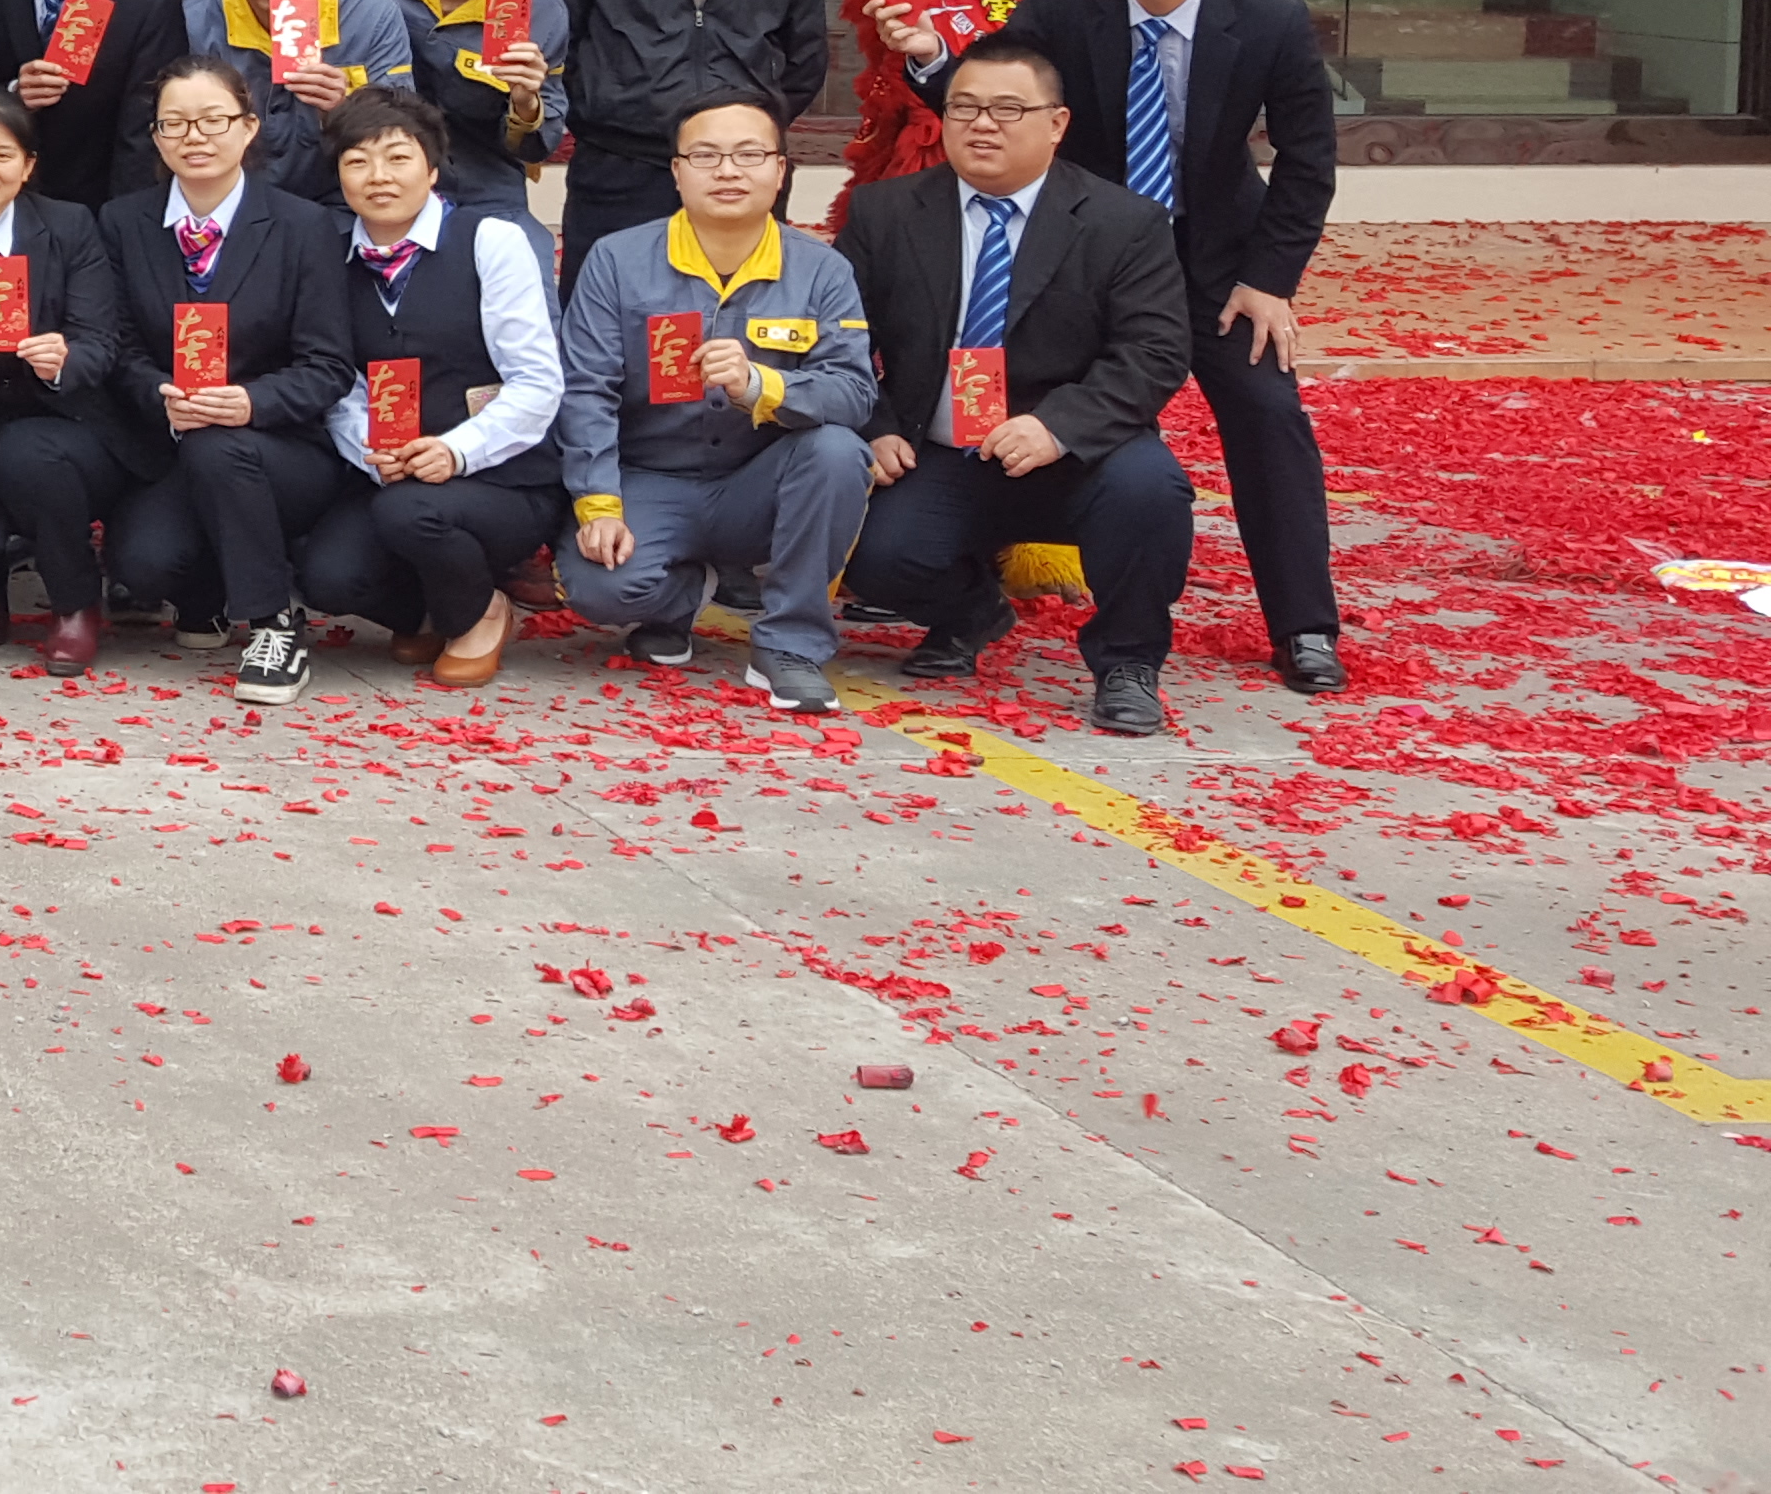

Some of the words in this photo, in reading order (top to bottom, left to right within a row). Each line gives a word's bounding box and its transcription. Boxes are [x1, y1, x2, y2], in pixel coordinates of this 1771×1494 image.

[272, 0, 306, 55] 大吉
[176, 308, 213, 371] 大吉
[651, 318, 690, 377] 大吉
[369, 364, 406, 423] 大吉
[953, 352, 991, 416] 大吉
